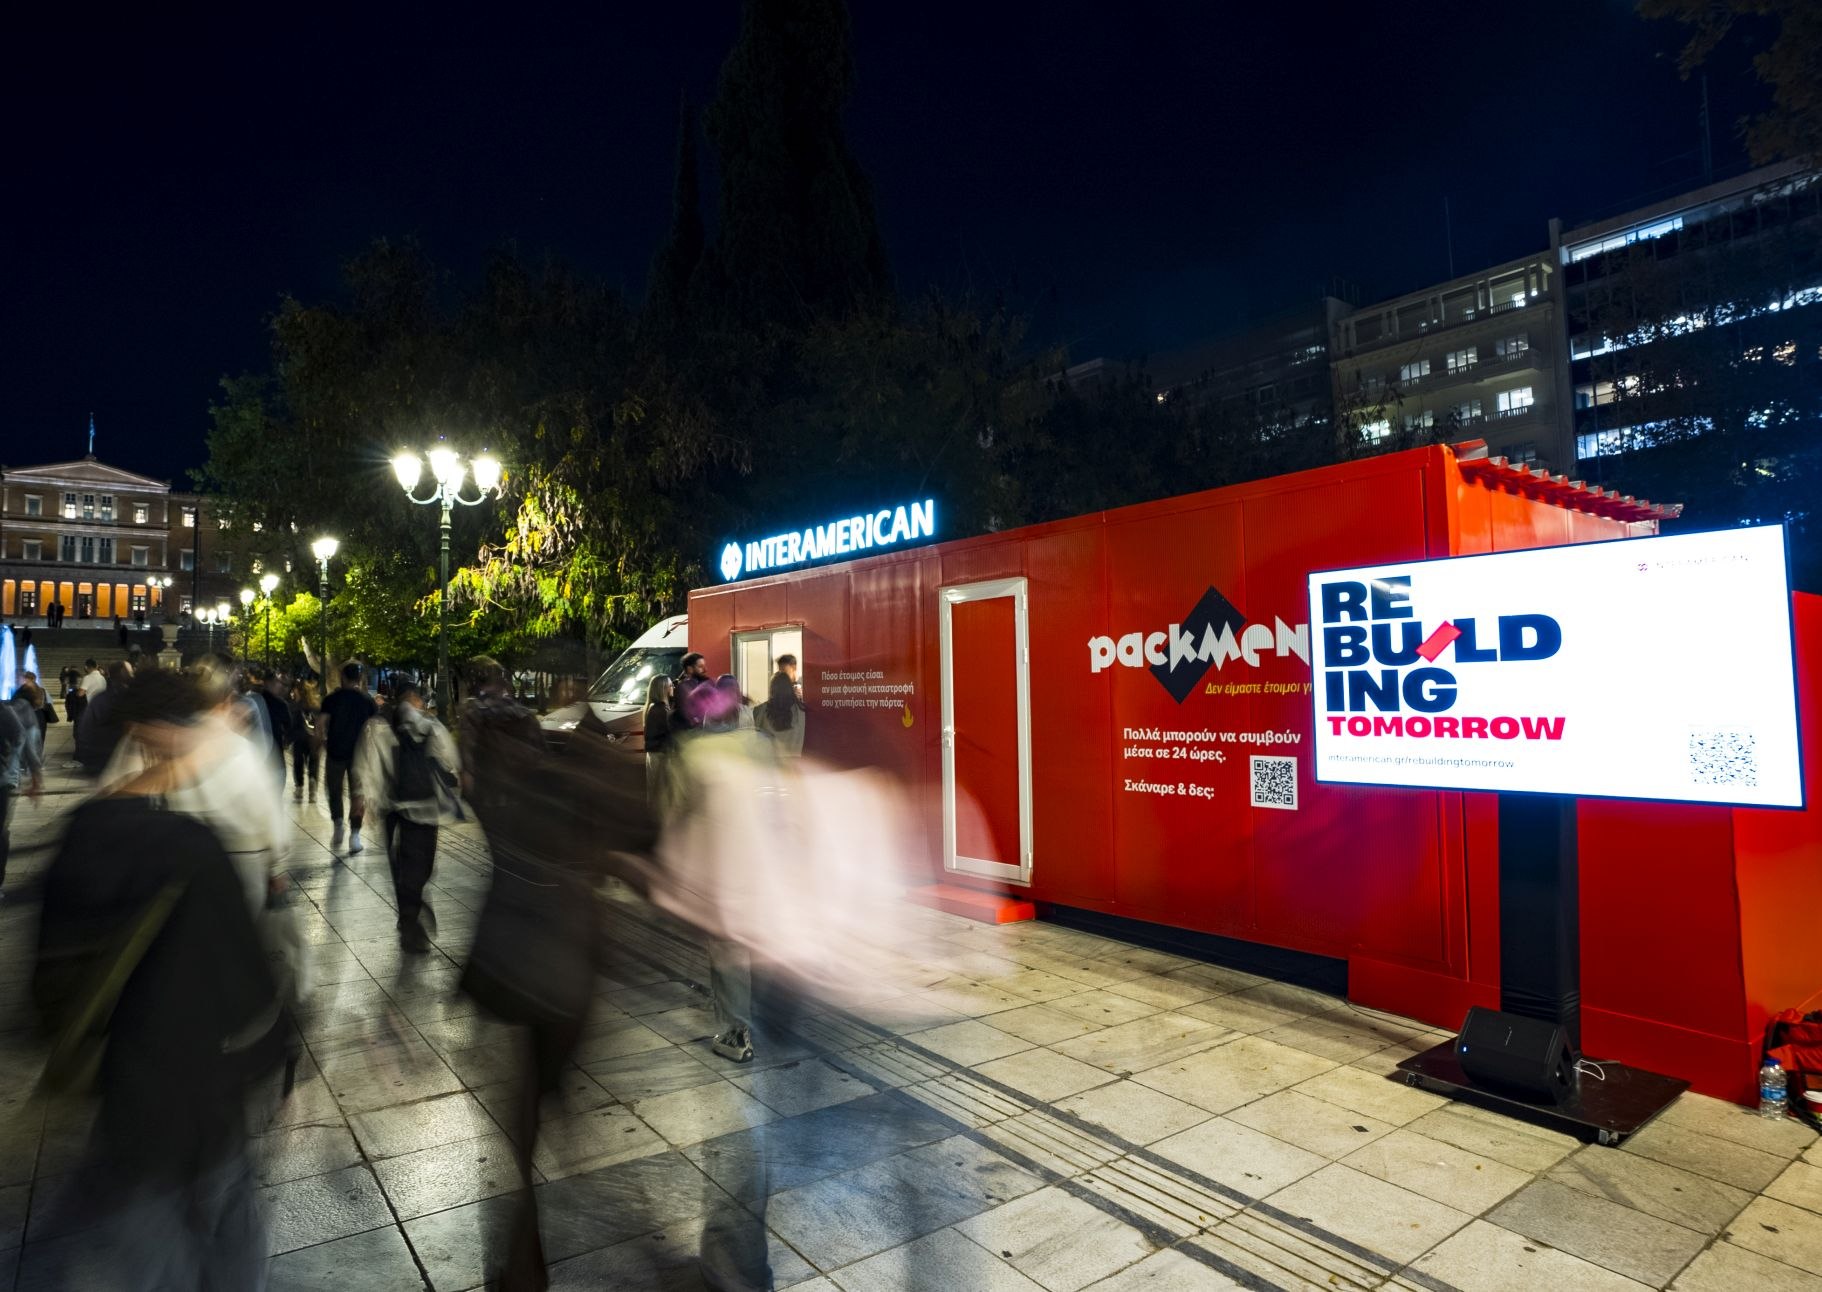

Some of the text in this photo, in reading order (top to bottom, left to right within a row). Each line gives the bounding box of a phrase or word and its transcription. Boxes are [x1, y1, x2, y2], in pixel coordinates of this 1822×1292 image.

[745, 499, 935, 572] INTERAMERICAN
[1321, 575, 1413, 624] RE
[821, 668, 884, 682] Πόσο έτοιμος είσαι
[821, 685, 830, 694] αν
[842, 682, 867, 696] φυσική
[867, 681, 914, 695] καταστροφή
[1205, 682, 1223, 695] Δεν
[1224, 681, 1262, 697] είμαστε
[1263, 681, 1301, 696] έτοιμοι
[1325, 667, 1458, 713] ING
[821, 699, 834, 707] σου
[834, 697, 866, 710] χτυπήσει
[866, 699, 879, 710] την
[1123, 727, 1301, 746] Πολλά μπορούν να συμβούν
[1327, 716, 1566, 741] TOMORROW
[1123, 744, 1226, 764] μέσα σε 24 ώρες.
[1328, 753, 1515, 769] interamerican.gr/rebuildingtomorrow
[1124, 779, 1175, 797] Σκάναρε
[1177, 783, 1187, 796] &
